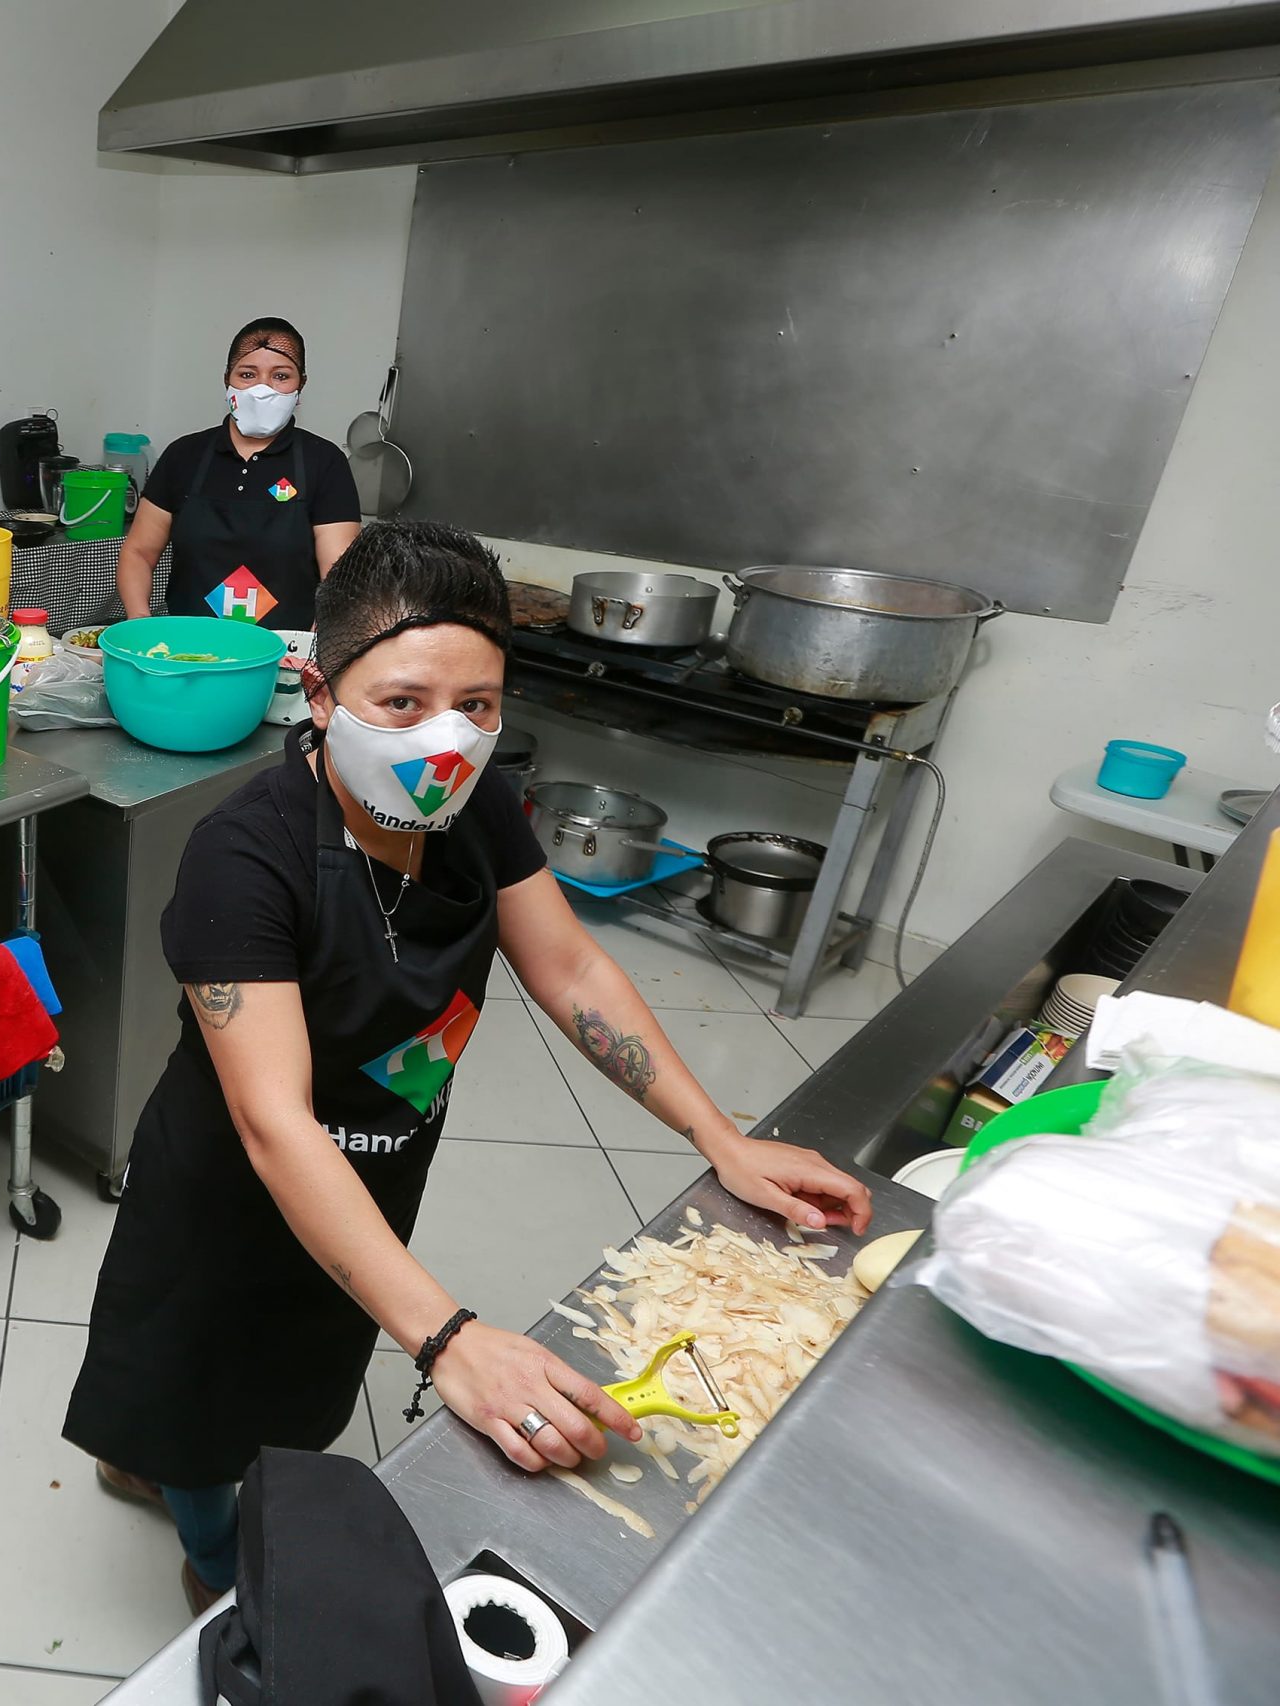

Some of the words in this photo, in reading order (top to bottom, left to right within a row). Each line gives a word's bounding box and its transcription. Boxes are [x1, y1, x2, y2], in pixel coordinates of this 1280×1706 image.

[276, 484, 289, 498] H
[222, 586, 258, 618] H
[412, 761, 462, 801] H
[363, 799, 436, 832] Handel
